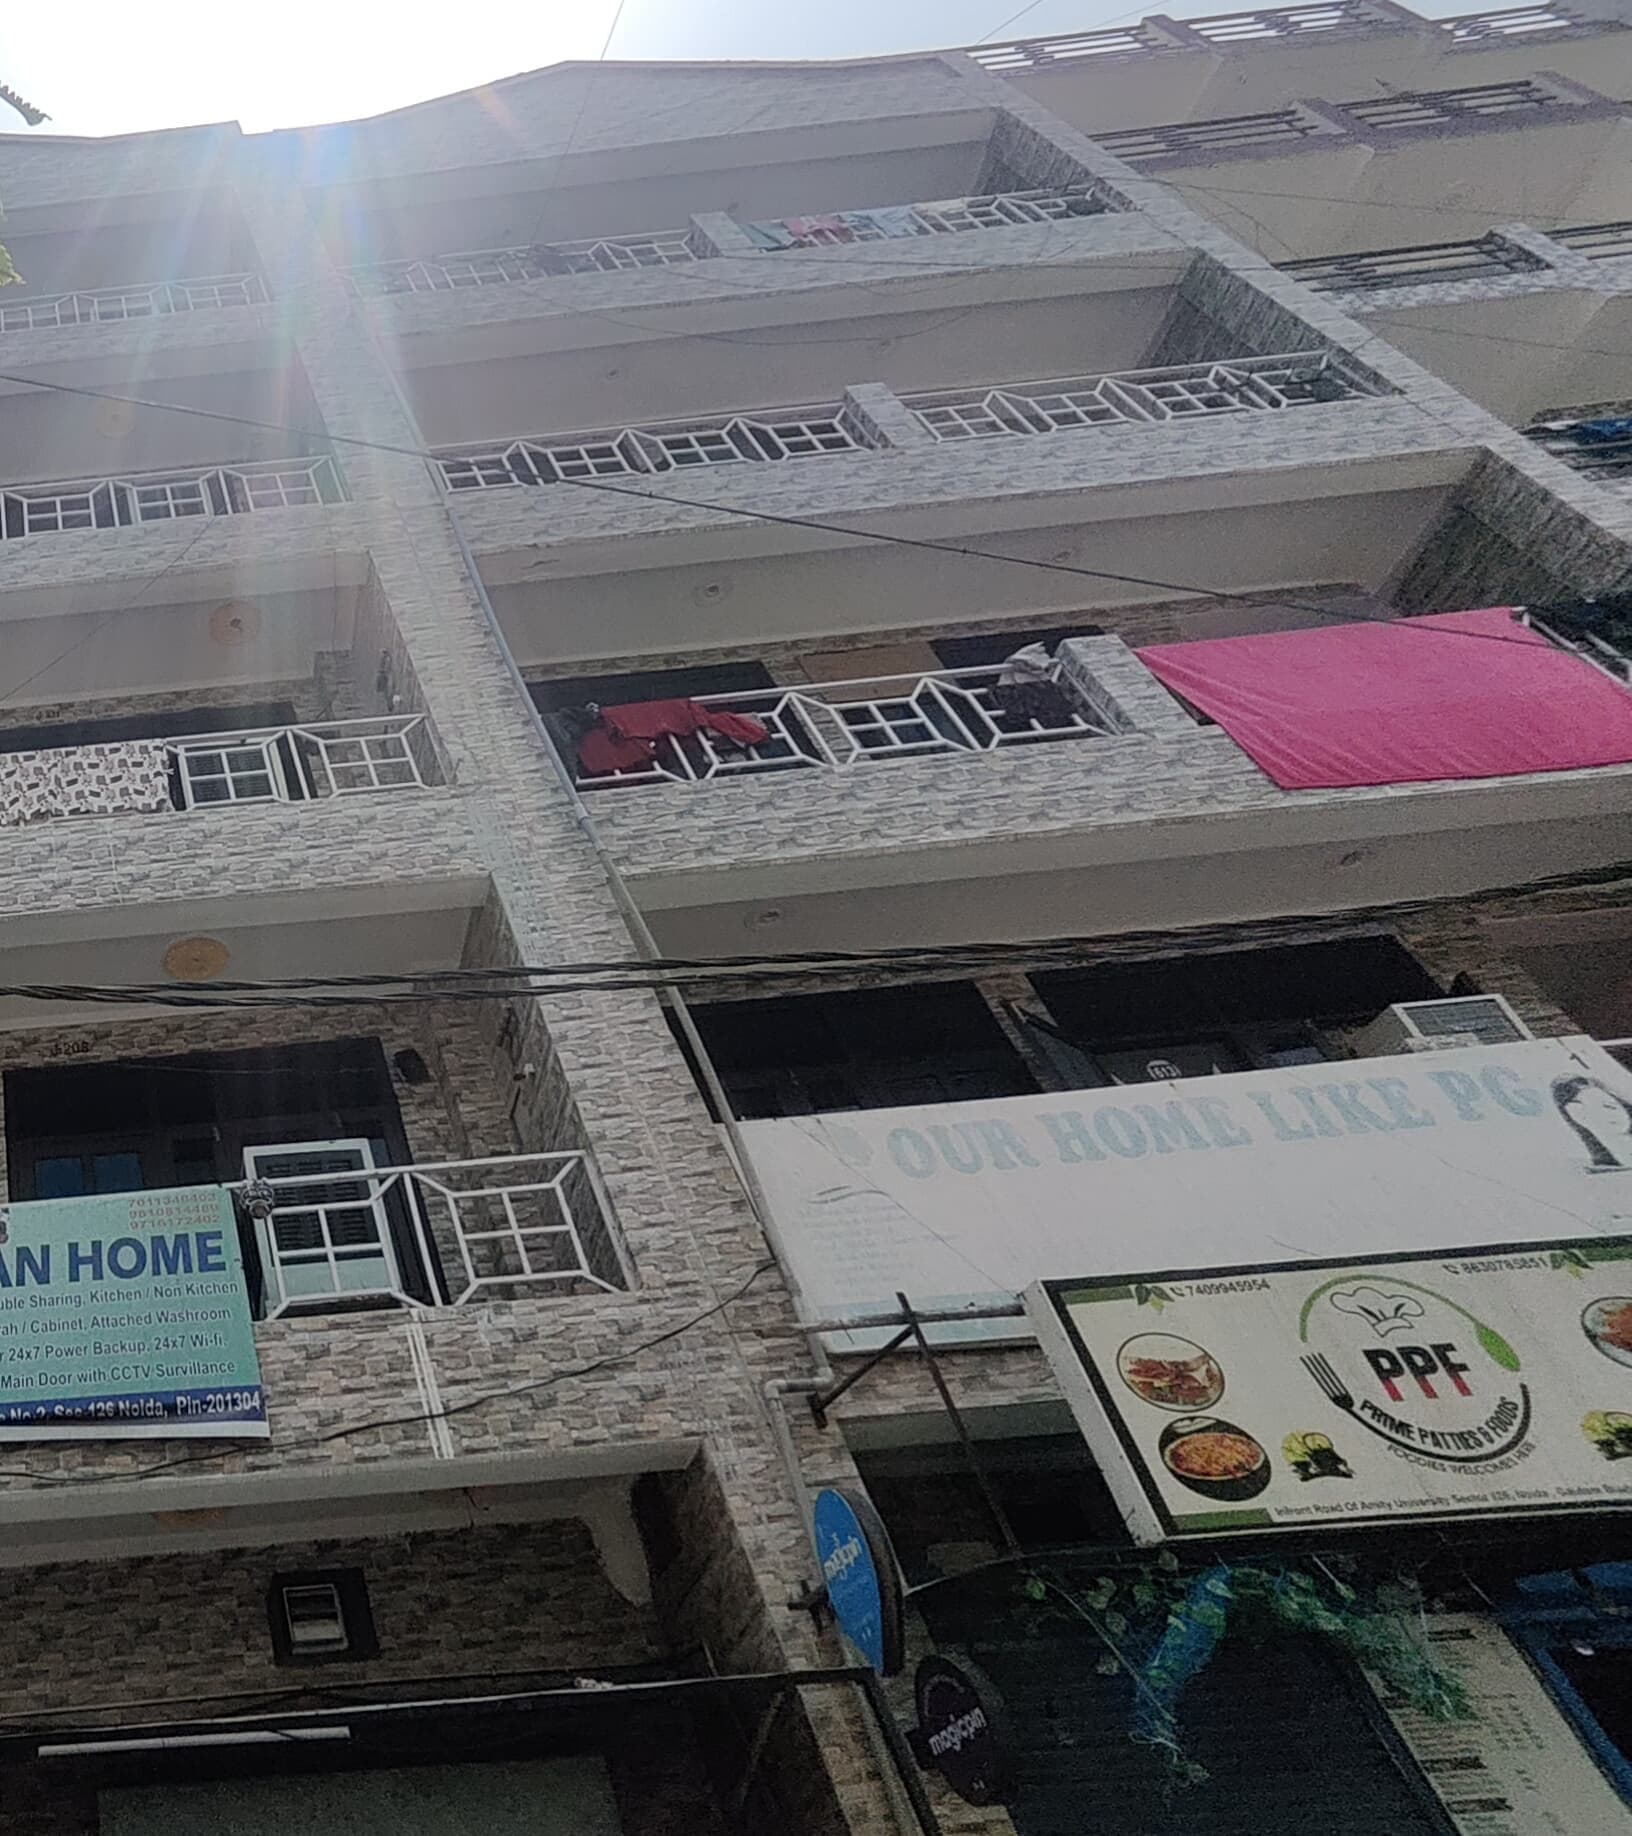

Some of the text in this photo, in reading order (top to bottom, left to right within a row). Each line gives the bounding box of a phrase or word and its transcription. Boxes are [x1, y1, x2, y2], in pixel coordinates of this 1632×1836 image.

[885, 1065, 1544, 1180] OUR HOME LIKE PG
[68, 1230, 226, 1282] HOME
[90, 1288, 143, 1303] Kitchen
[154, 1285, 182, 1299] Non
[186, 1281, 238, 1297] Kitchen
[91, 1312, 152, 1329] Attached
[156, 1307, 231, 1325] Washroom
[9, 1346, 40, 1361] 24x7
[45, 1343, 88, 1358] Power
[154, 1337, 186, 1351] 24x7
[0, 1374, 34, 1391] Main
[38, 1371, 72, 1387] Door
[77, 1367, 106, 1383] with
[111, 1364, 151, 1381] CCTV
[155, 1359, 235, 1379] Survillance
[1362, 1343, 1473, 1402] PPF
[175, 1391, 261, 1416] Pin-201304
[1360, 1399, 1416, 1441] PRIME
[1419, 1427, 1484, 1451] PATTIES
[1485, 1395, 1520, 1438] FOODS
[1387, 1444, 1447, 1474] FOODIES
[1313, 1503, 1343, 1514] Road
[1361, 1500, 1393, 1512] Amity
[1394, 1495, 1450, 1509] University
[1451, 1492, 1488, 1504] Sector
[824, 1534, 863, 1582] magicpin
[928, 1706, 988, 1755] magicpin
